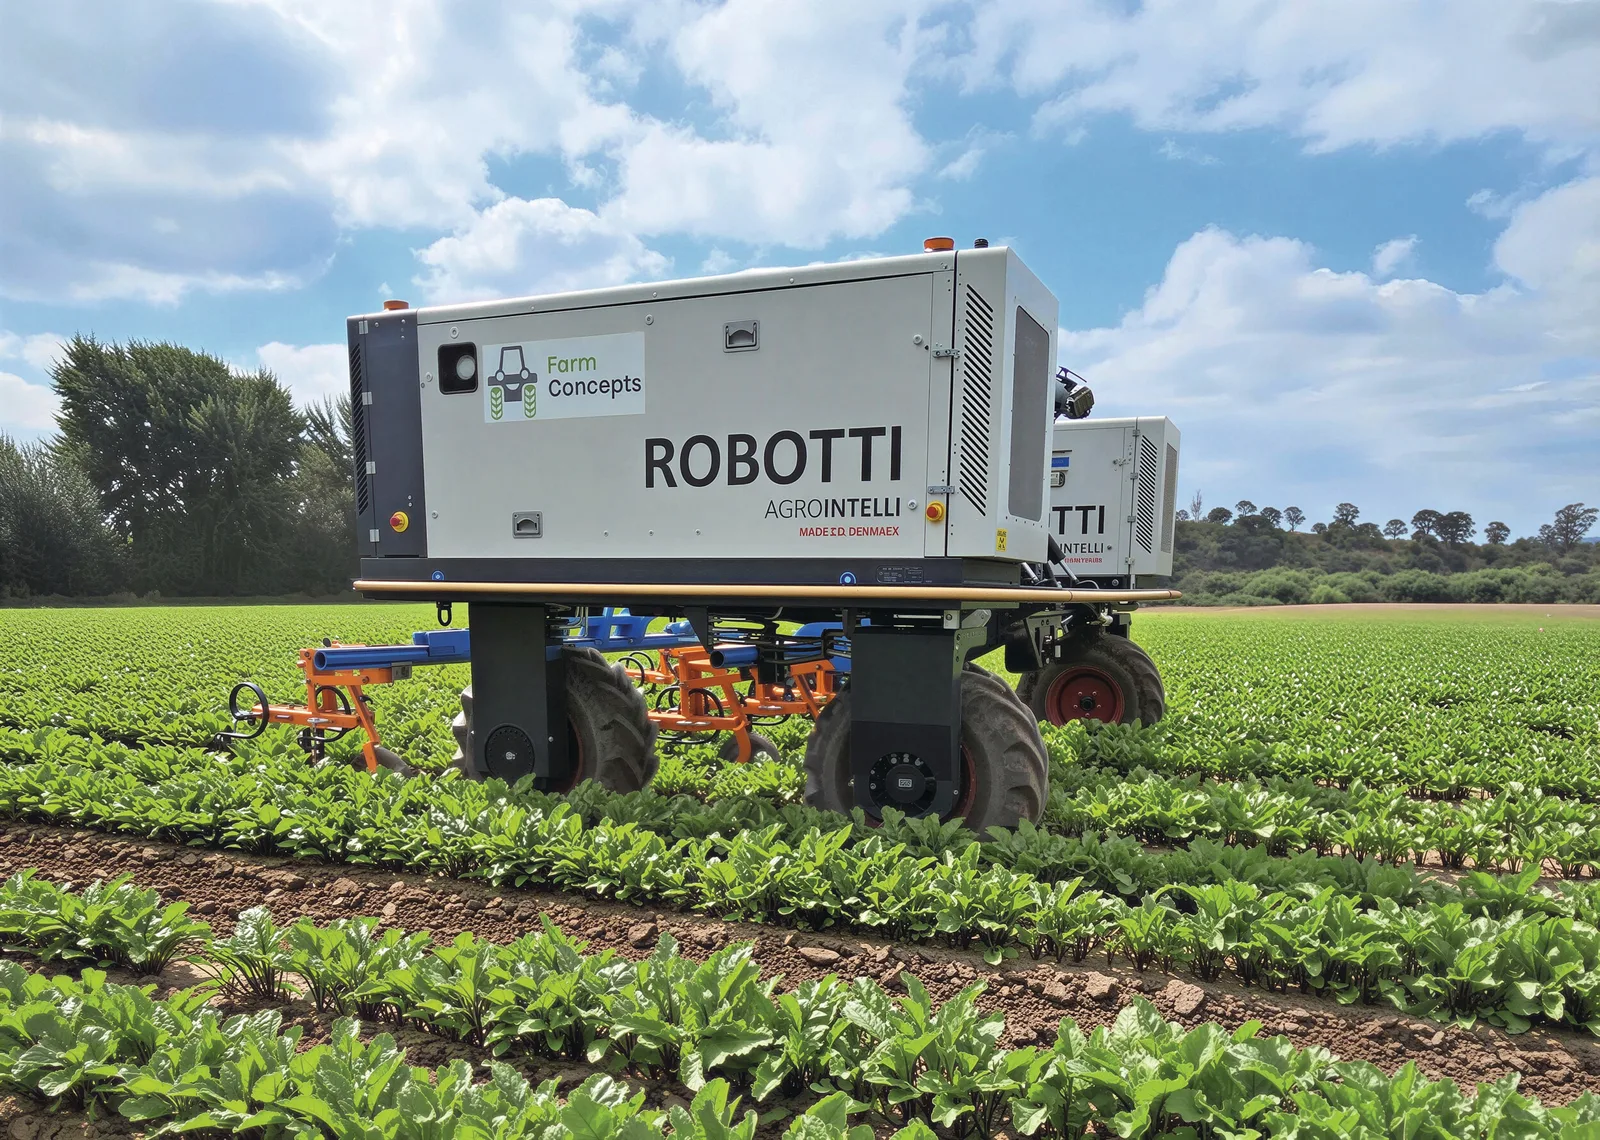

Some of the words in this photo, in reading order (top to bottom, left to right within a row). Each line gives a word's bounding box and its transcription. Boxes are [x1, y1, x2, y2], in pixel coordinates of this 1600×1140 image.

[547, 355, 597, 374] Farm
[548, 375, 642, 399] Concepts
[645, 425, 902, 488] ROBOTTI
[764, 497, 901, 519] AGROINTELLI
